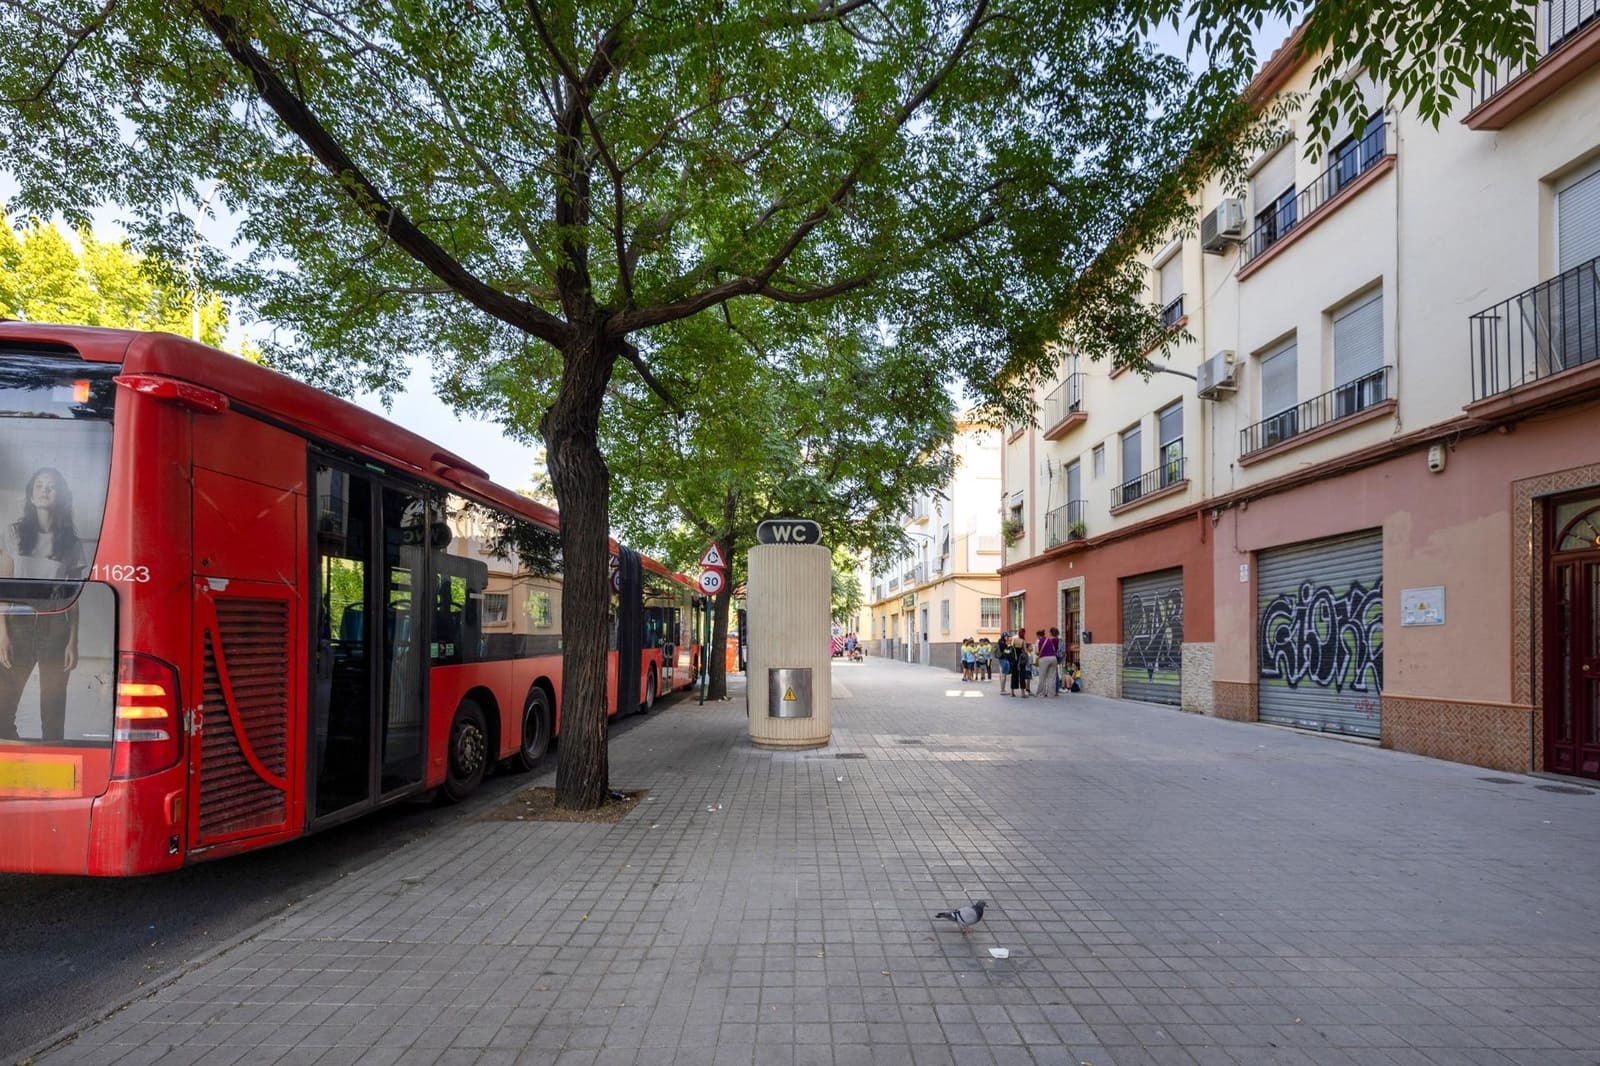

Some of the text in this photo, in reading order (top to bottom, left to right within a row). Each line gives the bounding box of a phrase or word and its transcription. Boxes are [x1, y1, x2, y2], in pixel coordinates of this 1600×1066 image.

[772, 525, 806, 541] WC
[92, 564, 150, 583] 11623
[704, 576, 719, 587] 30
